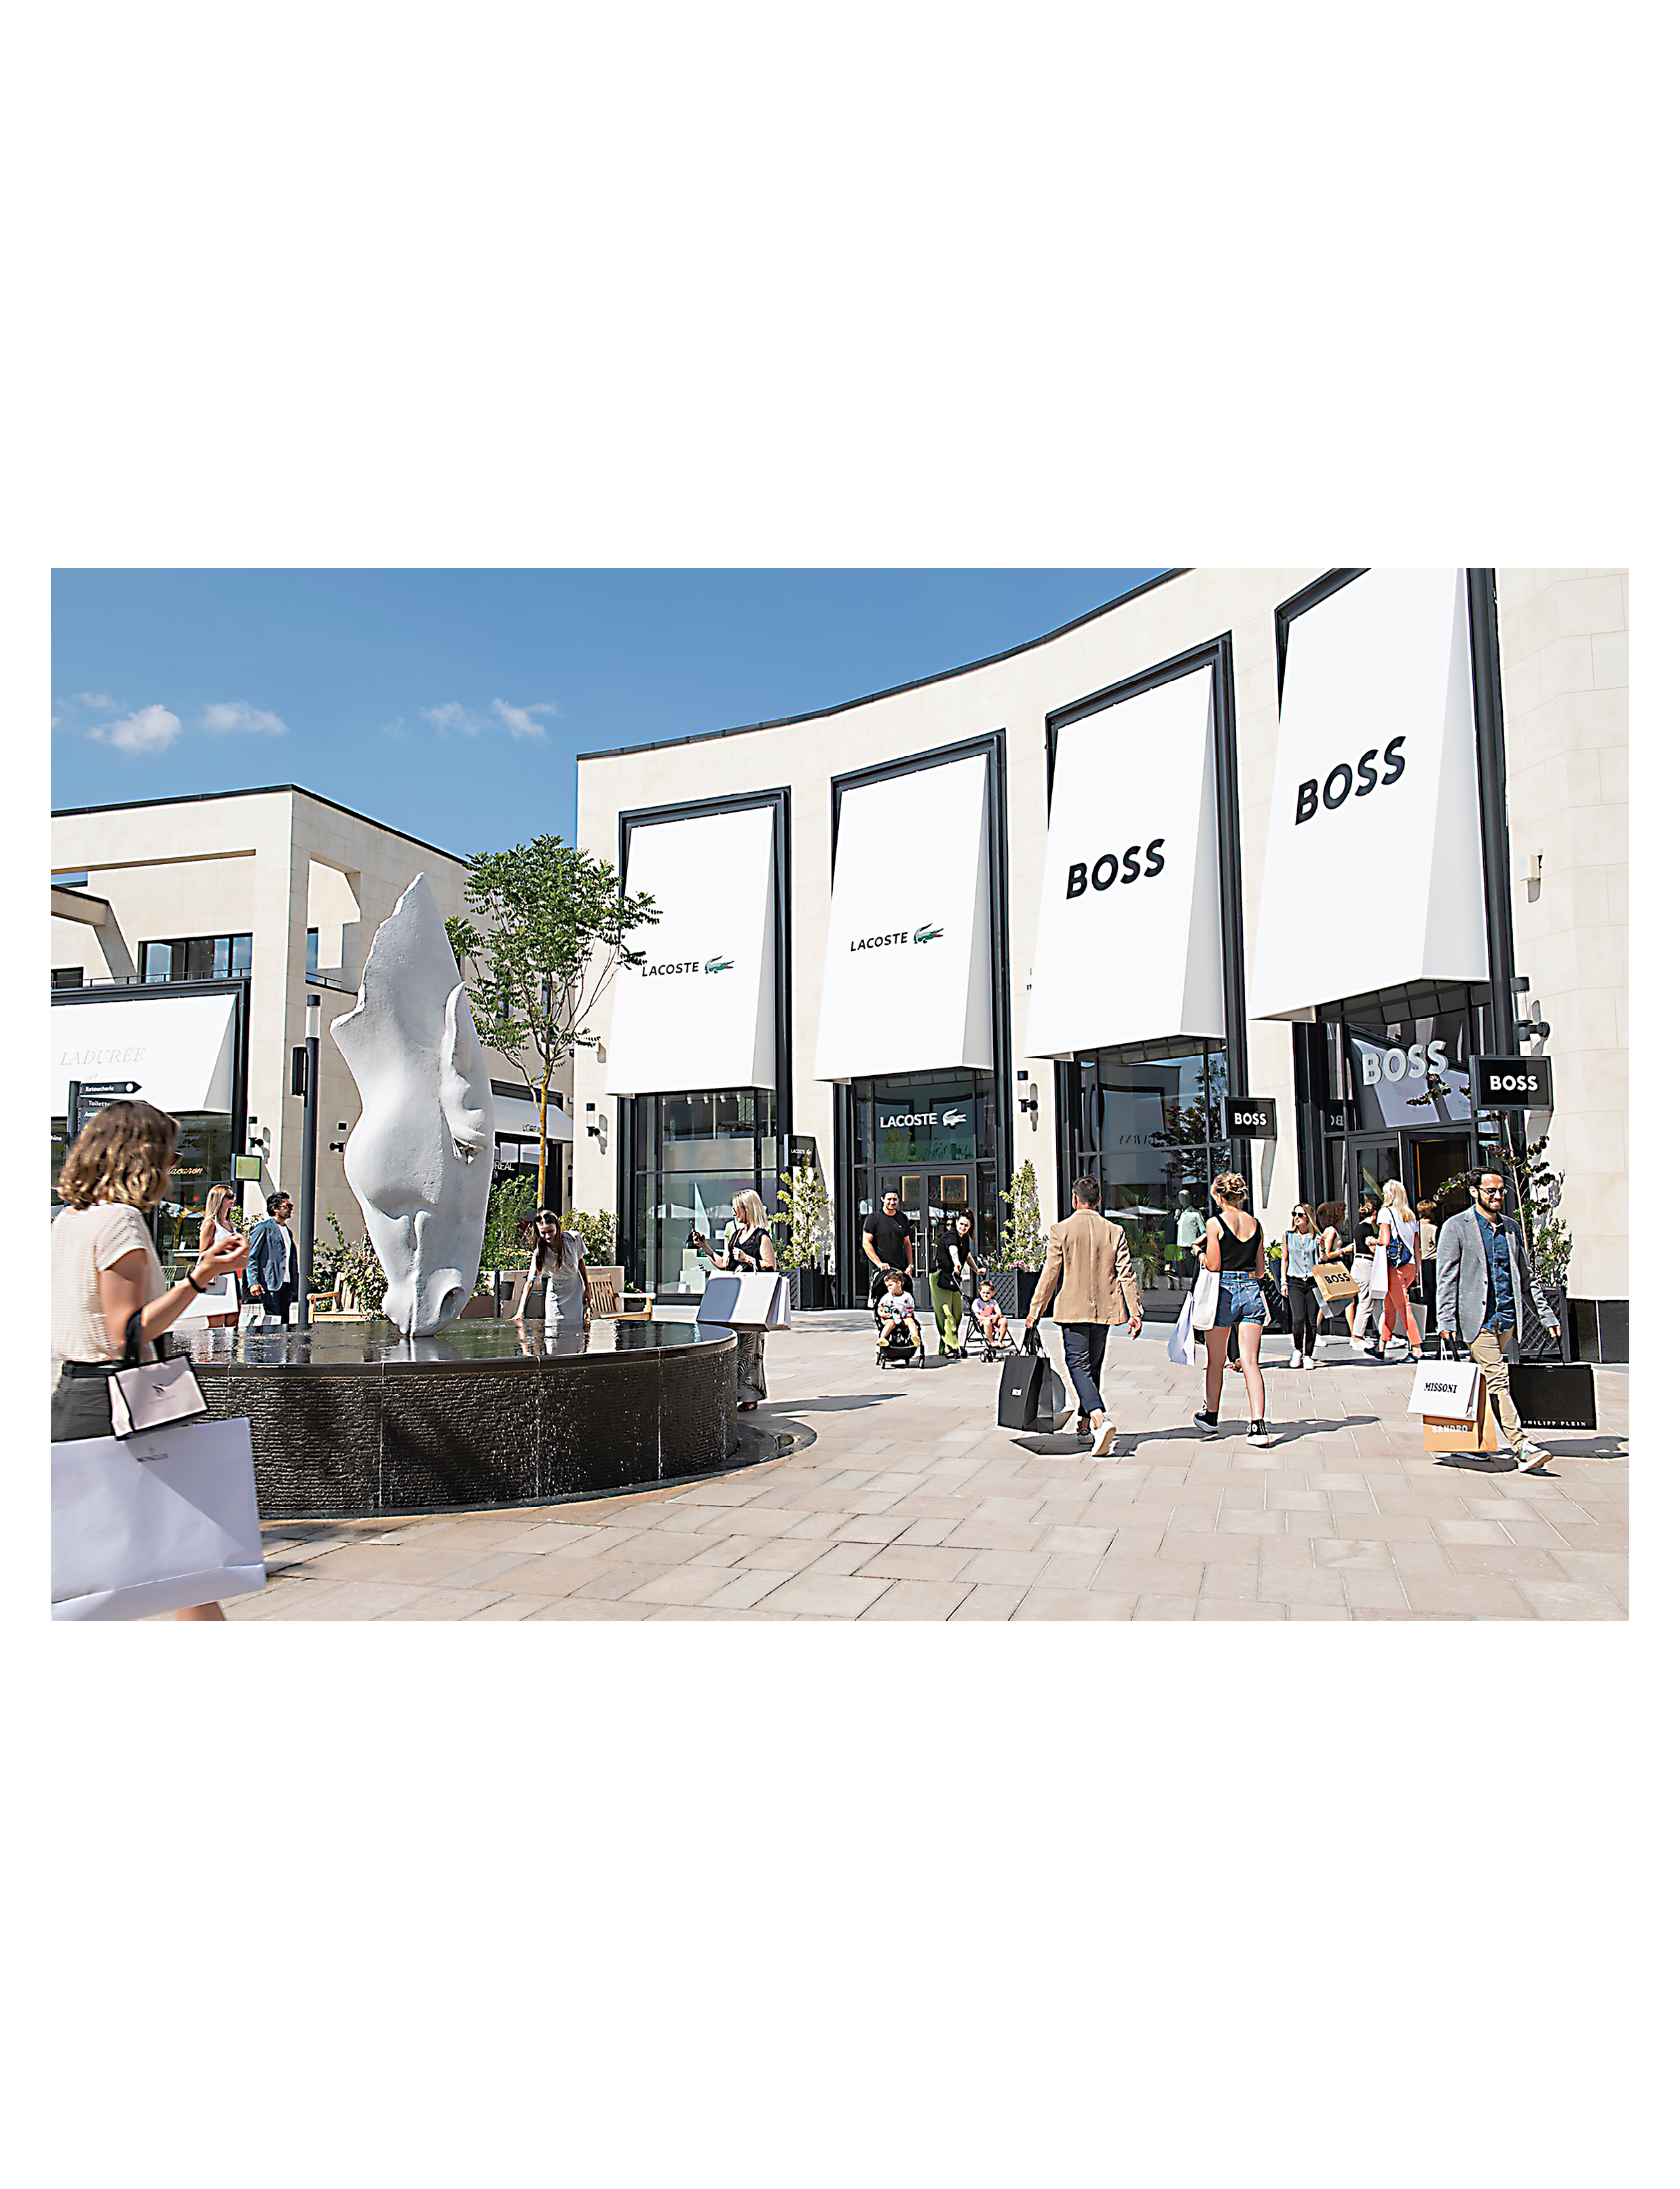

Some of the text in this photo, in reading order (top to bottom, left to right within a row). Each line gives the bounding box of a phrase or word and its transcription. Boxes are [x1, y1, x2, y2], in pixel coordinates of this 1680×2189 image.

[1295, 736, 1406, 825] BOSS
[1066, 838, 1165, 900] BOSS
[851, 931, 908, 952] LACOSTE
[642, 961, 699, 977] LACOSTE
[59, 1047, 145, 1066] LADURÉE
[1362, 1040, 1448, 1086] BOSS
[1489, 1074, 1538, 1091] BOSS
[880, 1112, 937, 1127] LACOSTE
[1234, 1112, 1267, 1125] BOSS
[1324, 1273, 1351, 1284] BOSS
[1424, 1382, 1457, 1393] MISSONI
[1432, 1424, 1468, 1434] SANDRO
